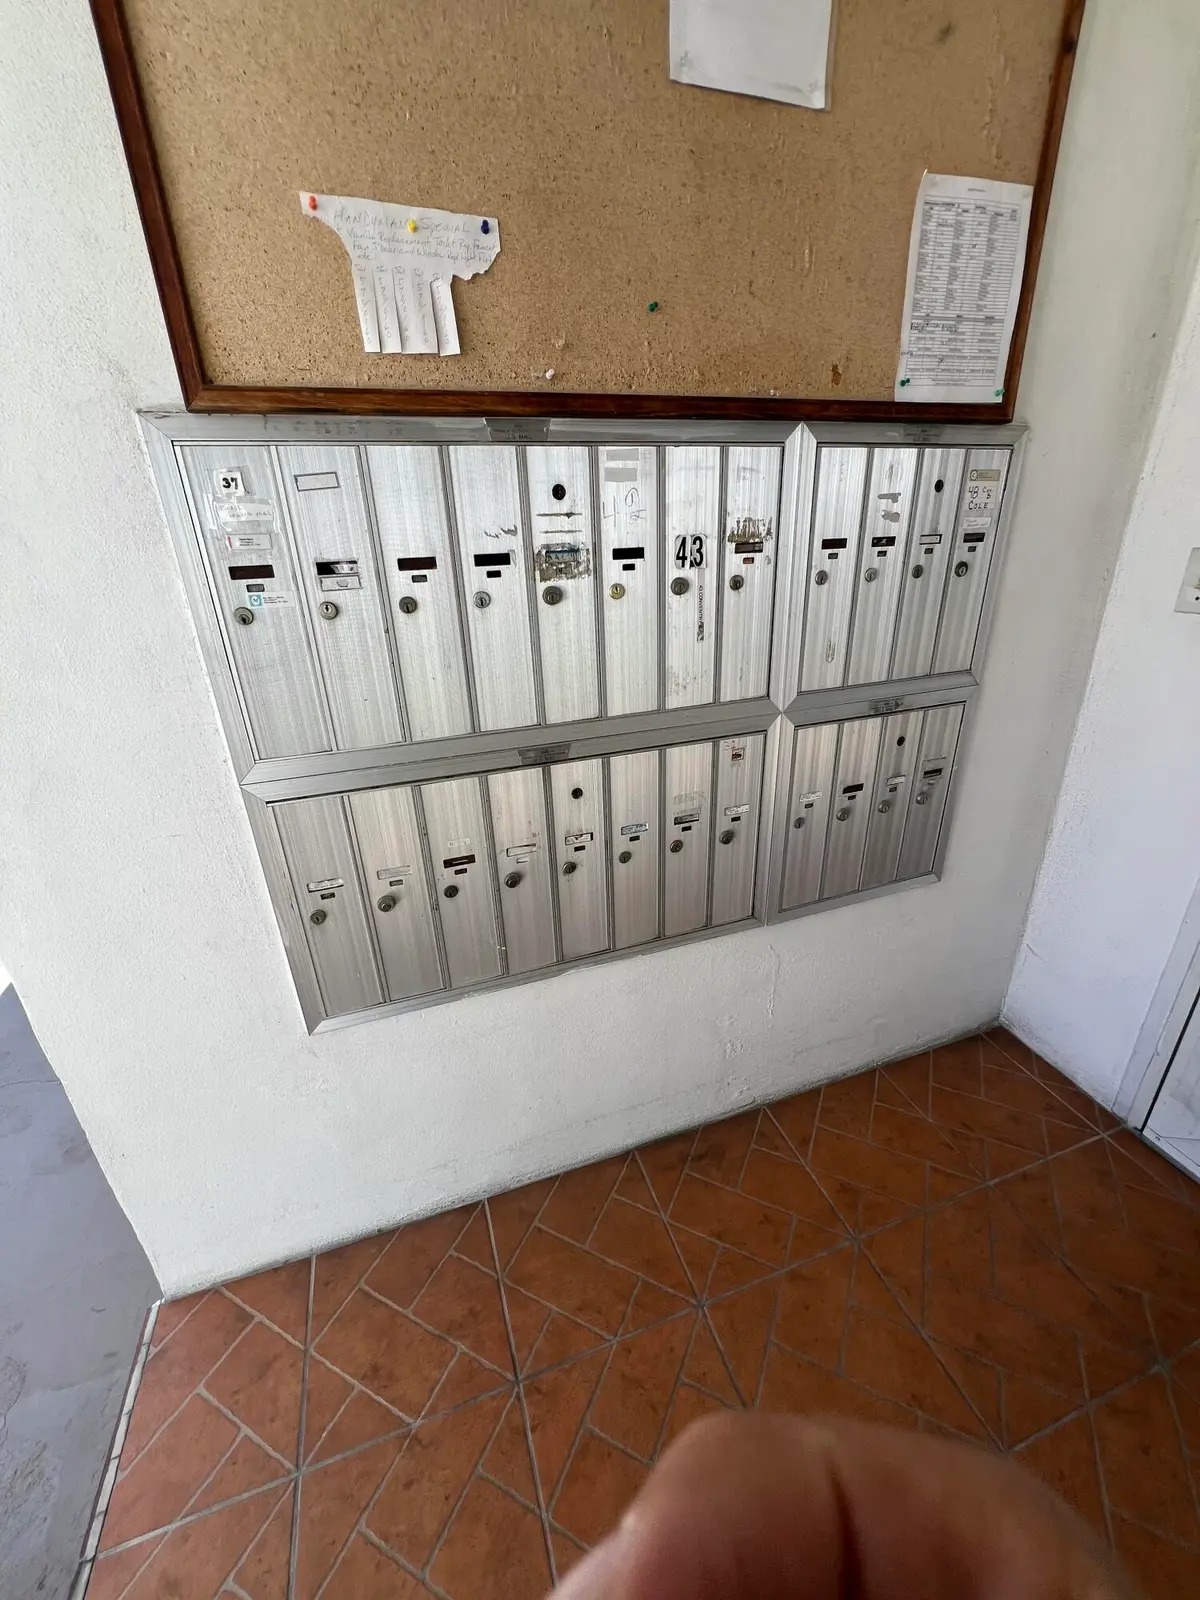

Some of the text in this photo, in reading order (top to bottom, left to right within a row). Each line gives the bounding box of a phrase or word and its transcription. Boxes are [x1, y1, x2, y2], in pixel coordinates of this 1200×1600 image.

[222, 477, 238, 490] 37
[968, 485, 979, 499] 48
[675, 536, 704, 568] 43
